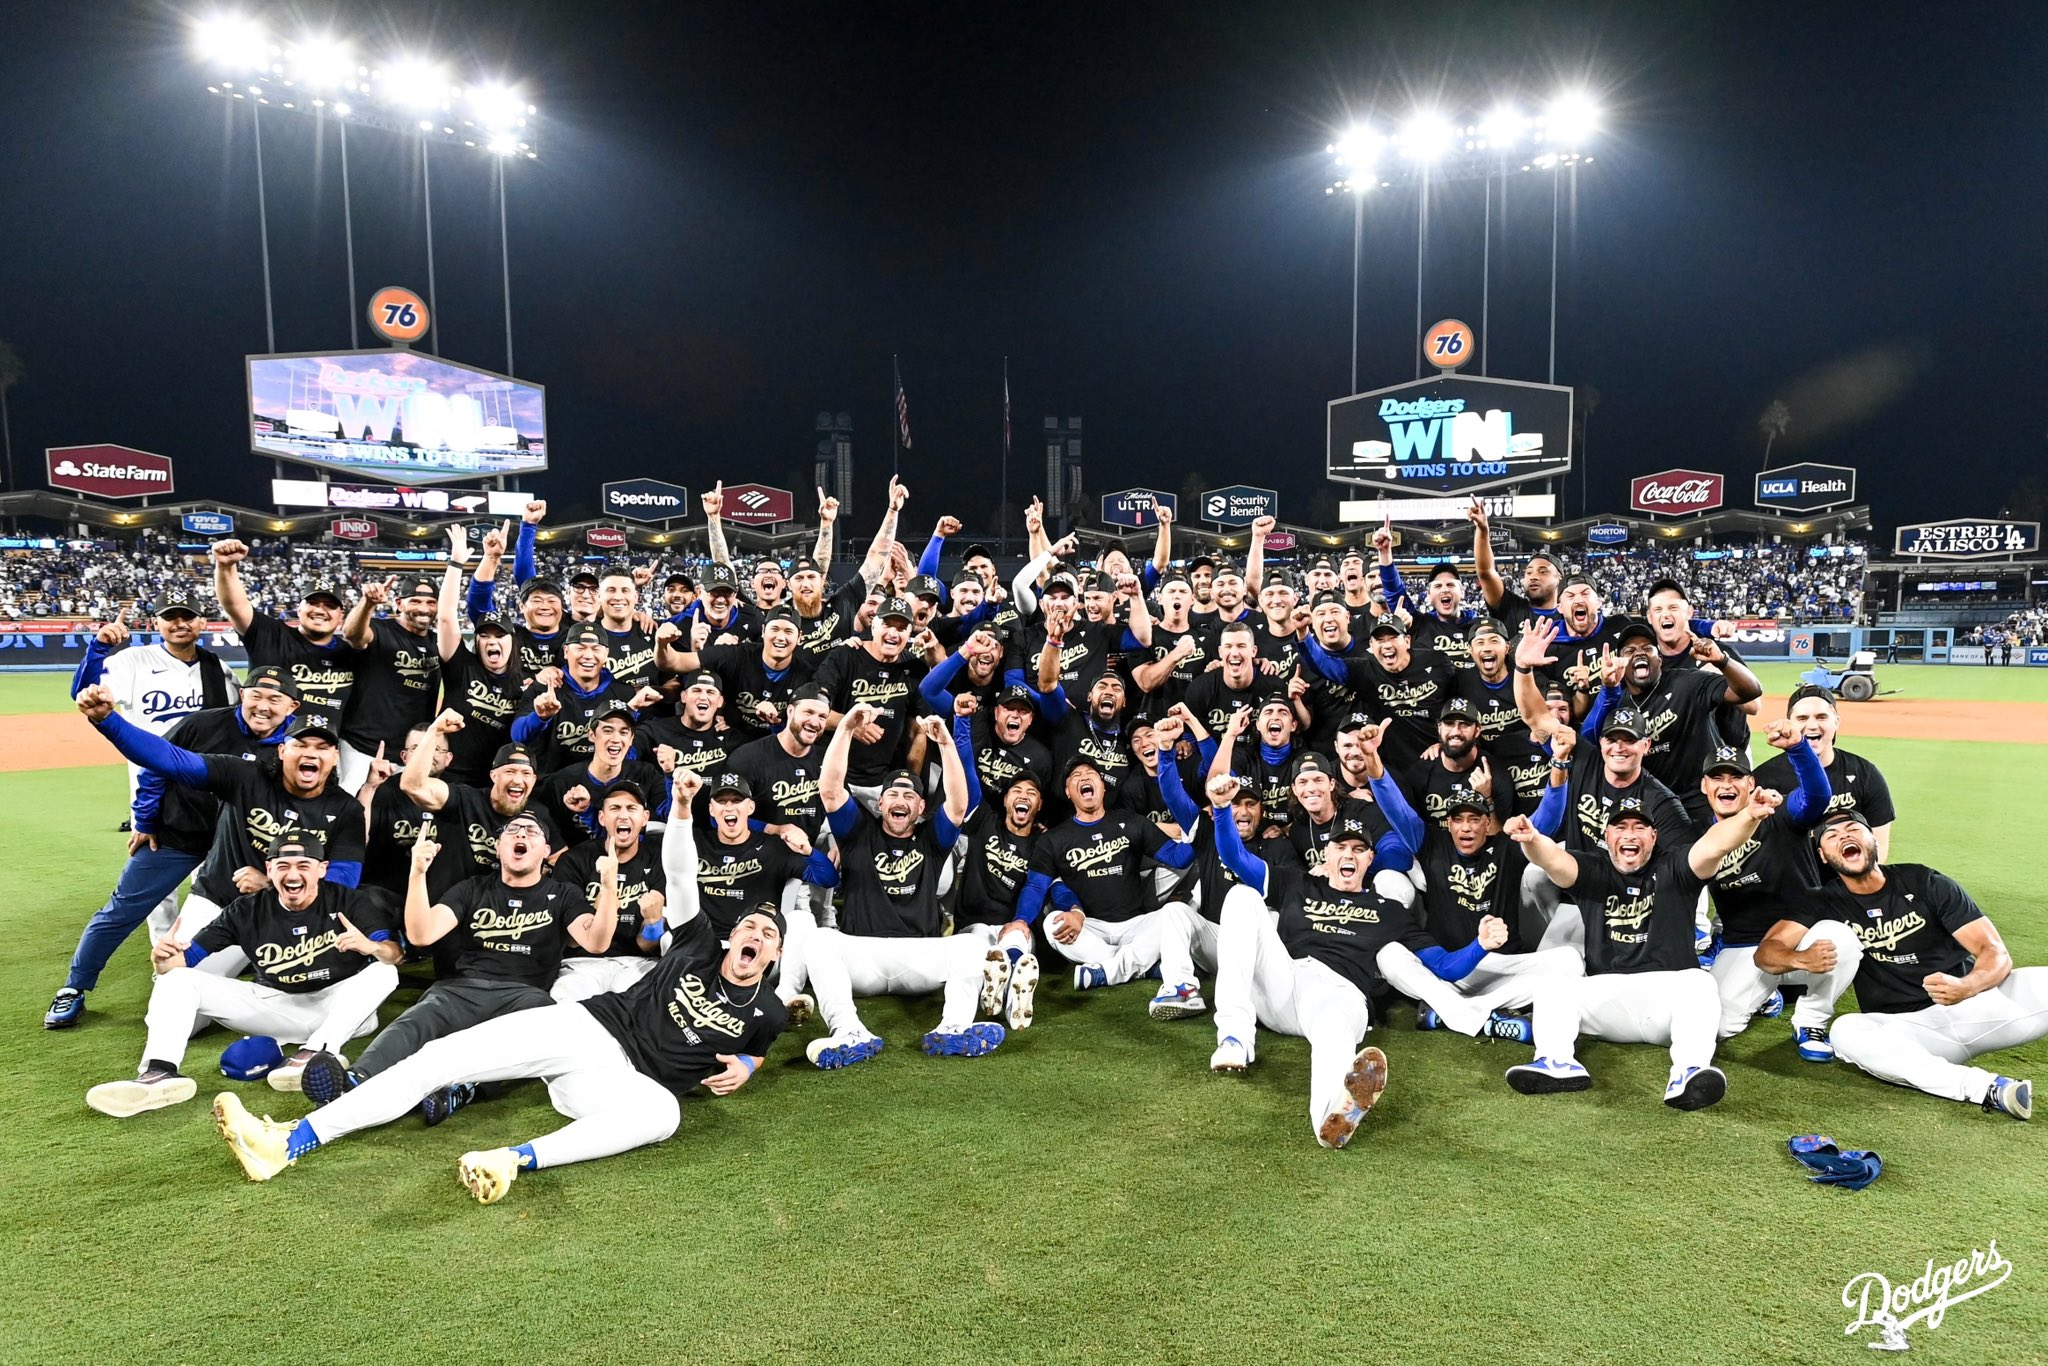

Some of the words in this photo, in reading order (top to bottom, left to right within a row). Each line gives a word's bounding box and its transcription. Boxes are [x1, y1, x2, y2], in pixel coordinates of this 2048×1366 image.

[383, 303, 418, 327] 76
[1433, 333, 1463, 356] 76
[1378, 397, 1465, 422] Dodgers
[1388, 409, 1512, 462] WIN
[353, 445, 411, 464] WINS
[414, 447, 443, 464] TO
[1385, 464, 1397, 479] 8
[1401, 463, 1446, 478] WINS
[1450, 462, 1474, 477] TO
[1477, 461, 1507, 476] GO!
[1762, 482, 1794, 494] UCLA
[1801, 479, 1846, 494] Health
[610, 490, 676, 507] Spectrum
[1229, 495, 1270, 507] Security
[188, 515, 219, 523] TOYO
[1230, 505, 1265, 517] Benefit
[193, 522, 228, 531] TIRES
[339, 522, 370, 533] JINRO
[1590, 527, 1626, 536] MORTON
[590, 533, 624, 542] Yakult
[1908, 538, 1999, 553] JALISCO
[991, 609, 1018, 625] gers
[812, 644, 831, 655] NLCS
[1794, 639, 1809, 649] 76
[605, 646, 654, 680] Dodgers
[404, 678, 422, 690] NLCS
[851, 677, 908, 704] Dodgers
[303, 693, 327, 706] NLCS
[1377, 680, 1438, 707] Dodgers
[471, 710, 490, 724] NLCS
[672, 745, 726, 772] Dodgers
[1508, 764, 1552, 792] Dodg
[772, 777, 820, 807] Dodge
[1066, 836, 1129, 871] Dodgers
[697, 857, 763, 885] Dodgers
[1088, 865, 1108, 878] NLCS
[704, 886, 725, 897] NLCS
[1305, 900, 1381, 925] Dodgers
[470, 906, 553, 940] Dodgers
[1313, 922, 1335, 935] NLCS
[1611, 930, 1635, 944] NLCS
[256, 929, 342, 975] Dodgers
[510, 943, 532, 952] 2024
[279, 971, 307, 984] NLCS
[674, 973, 745, 1039] Dodgers
[668, 1001, 688, 1030] NLCS
